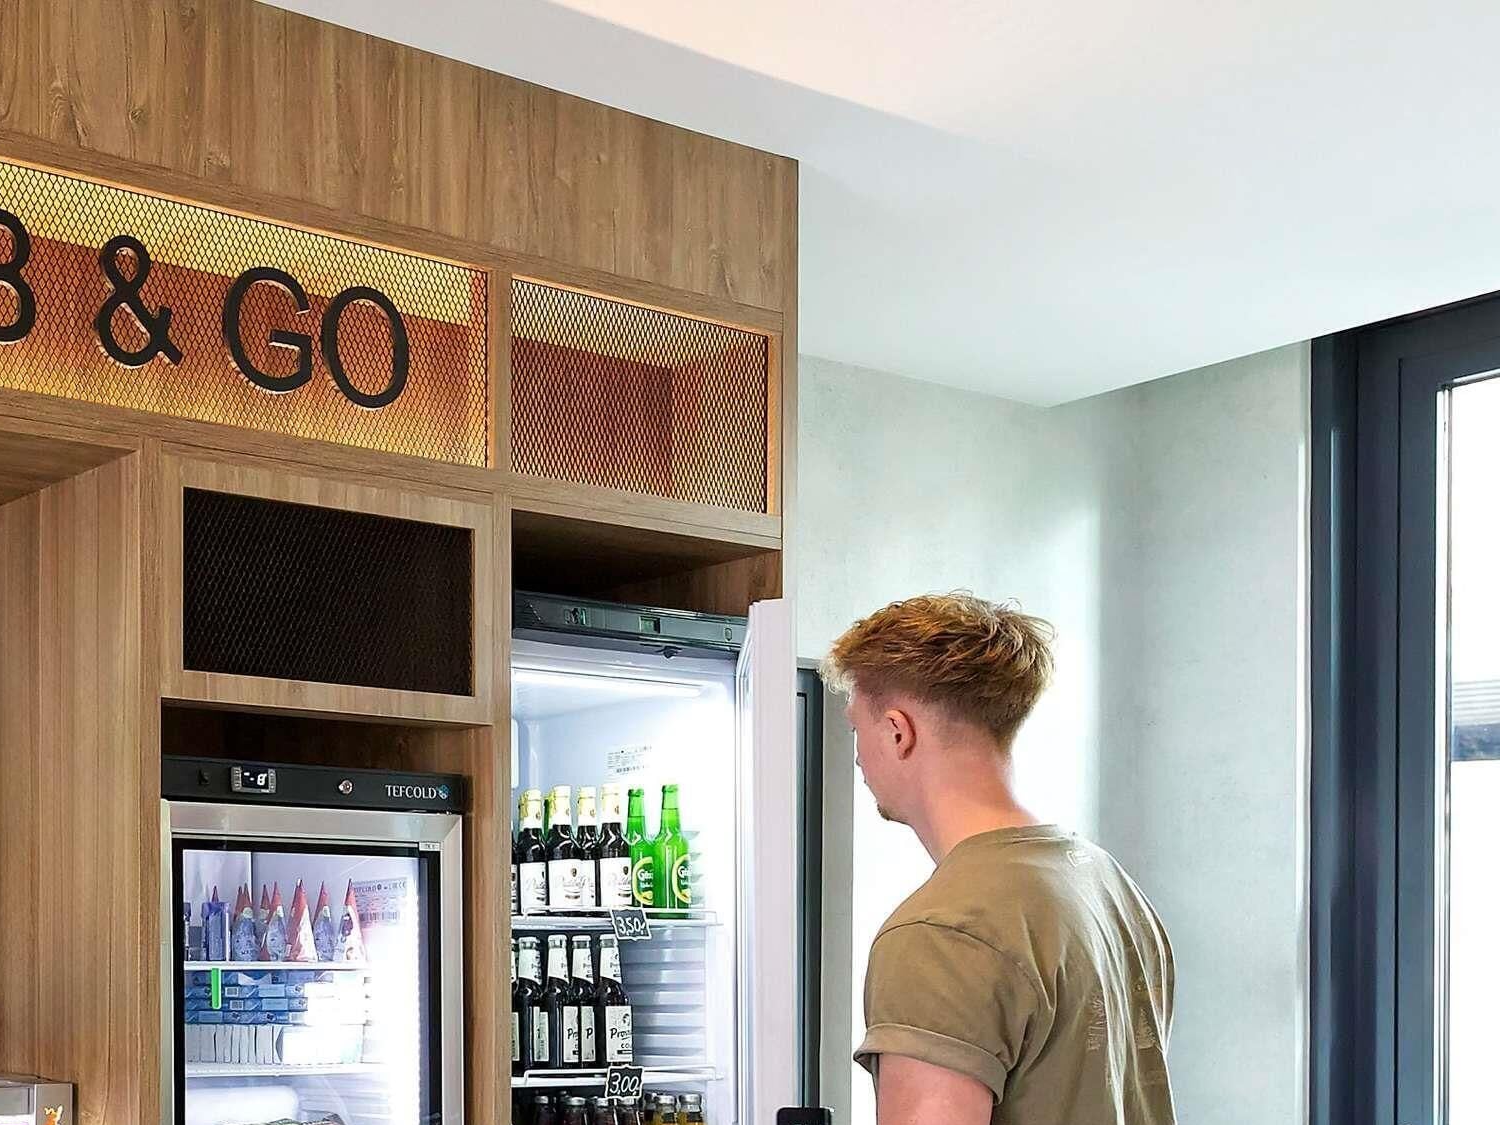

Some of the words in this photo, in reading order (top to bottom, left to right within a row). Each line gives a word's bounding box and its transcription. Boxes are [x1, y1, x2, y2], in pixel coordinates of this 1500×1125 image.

[96, 233, 184, 370] &
[222, 265, 412, 412] GO
[385, 784, 437, 799] TEFCOLD
